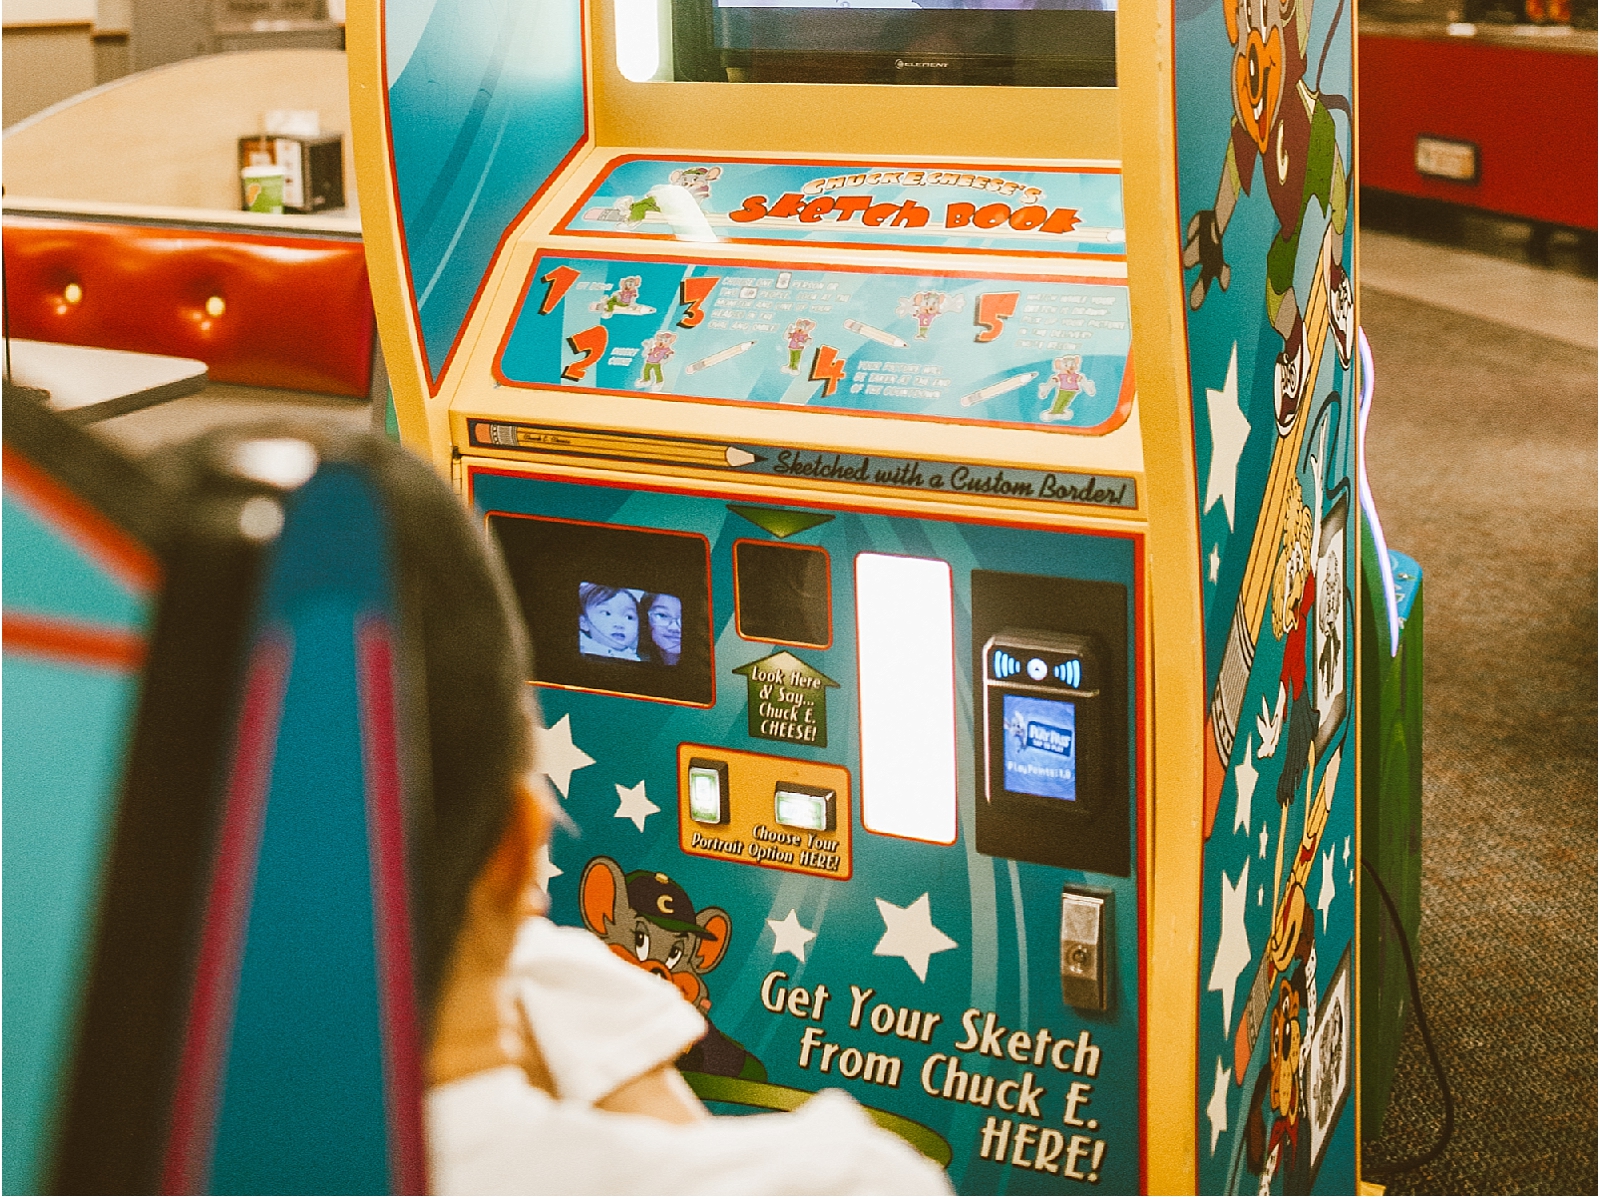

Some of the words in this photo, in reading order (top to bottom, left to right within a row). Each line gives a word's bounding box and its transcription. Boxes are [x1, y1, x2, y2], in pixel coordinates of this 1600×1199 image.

[803, 171, 901, 196] CHUCK
[927, 170, 1046, 205] CHEESE'S
[538, 265, 581, 316] 1
[676, 277, 721, 328] 3
[973, 291, 1020, 343] 5
[560, 325, 608, 381] 2
[808, 345, 846, 398] 4
[774, 450, 871, 482] Sketched
[873, 460, 923, 487] with
[929, 472, 945, 489] a
[950, 466, 1034, 496] Custom
[1038, 473, 1126, 505] Border!
[752, 665, 785, 684] Look
[790, 671, 821, 689] Here
[760, 684, 773, 700] &
[778, 687, 814, 707] Say...
[760, 702, 798, 721] Chuck
[804, 708, 816, 724] E.
[761, 720, 817, 742] CHEESE!
[691, 832, 744, 855] Portrait
[748, 842, 795, 863] Option
[799, 850, 841, 871] HERE!
[752, 825, 802, 846] Choose
[807, 833, 840, 853] Your
[761, 970, 831, 1023] Get
[850, 985, 942, 1044] Your
[955, 1008, 1102, 1078] Sketch
[798, 1027, 902, 1088] From
[922, 1053, 1046, 1120] Chuck
[1065, 1082, 1100, 1130] E.
[980, 1115, 1108, 1184] HERE!
